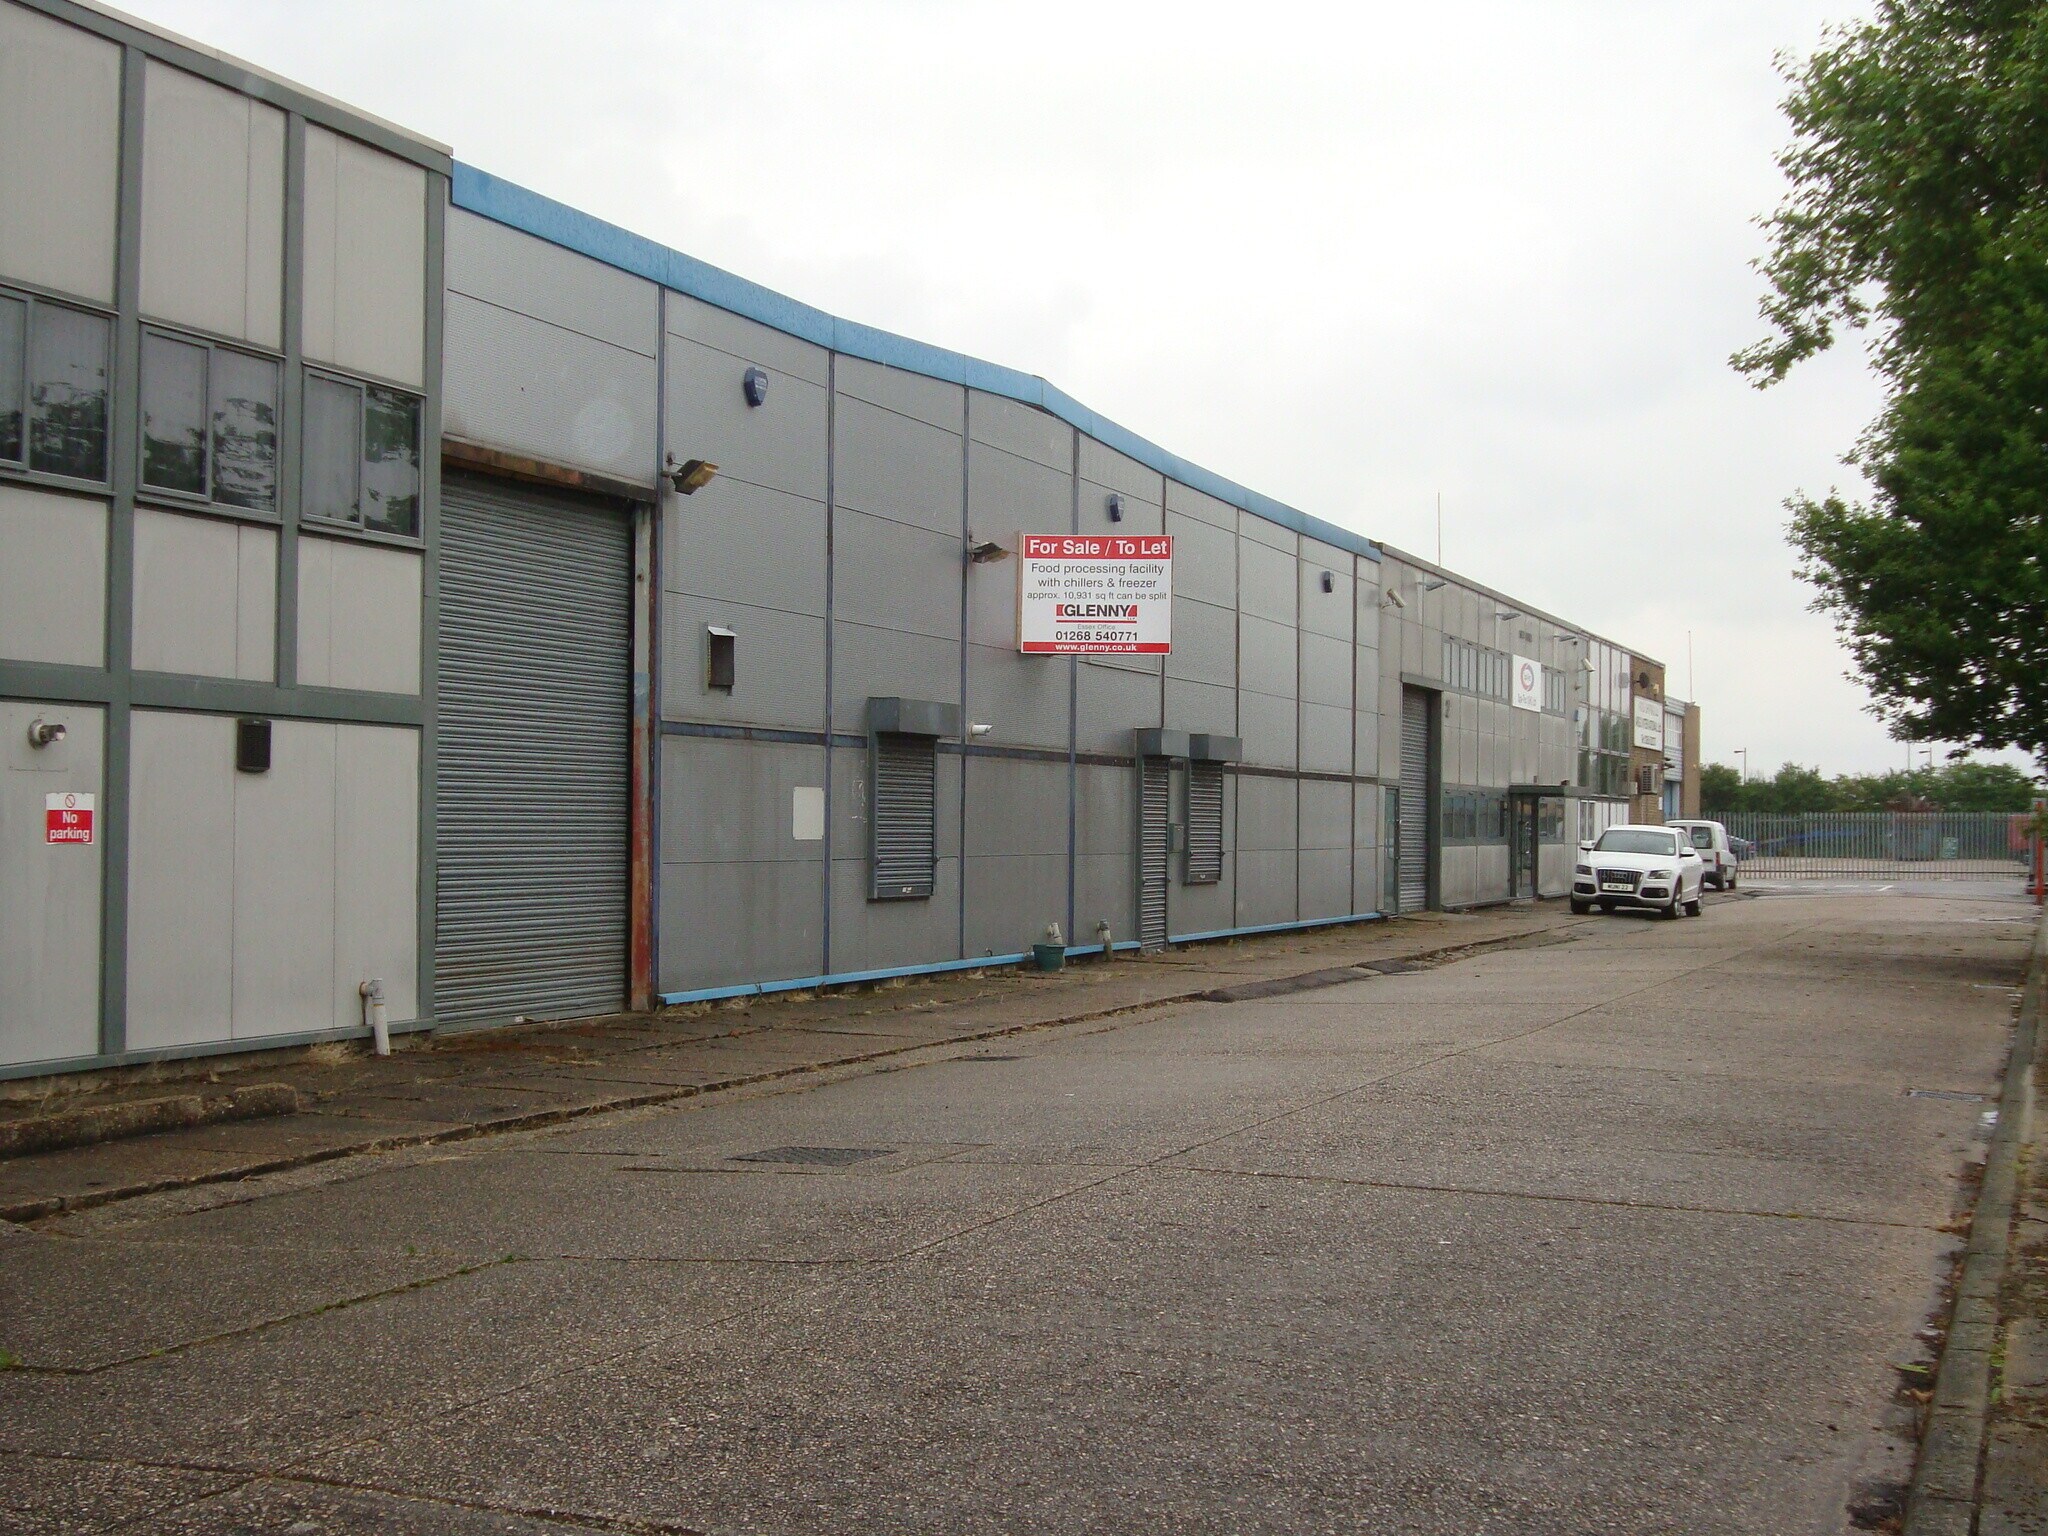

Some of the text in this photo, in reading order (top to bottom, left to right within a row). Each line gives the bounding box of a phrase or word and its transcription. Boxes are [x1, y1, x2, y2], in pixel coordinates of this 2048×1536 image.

[1029, 539, 1167, 556] For Sale / To Let
[1031, 563, 1164, 576] Food processing facility
[1038, 577, 1157, 588] with chillers & freezer
[1027, 592, 1060, 600] approx.
[1095, 593, 1105, 601] sq
[1108, 592, 1115, 600] ft
[1135, 592, 1147, 600] be
[1149, 592, 1167, 601] split
[1064, 604, 1130, 617] GLENNY
[1055, 631, 1138, 641] 01268 540771
[1055, 643, 1137, 652] www.glenny.co.uk
[62, 811, 78, 823] No
[50, 827, 90, 842] parking
